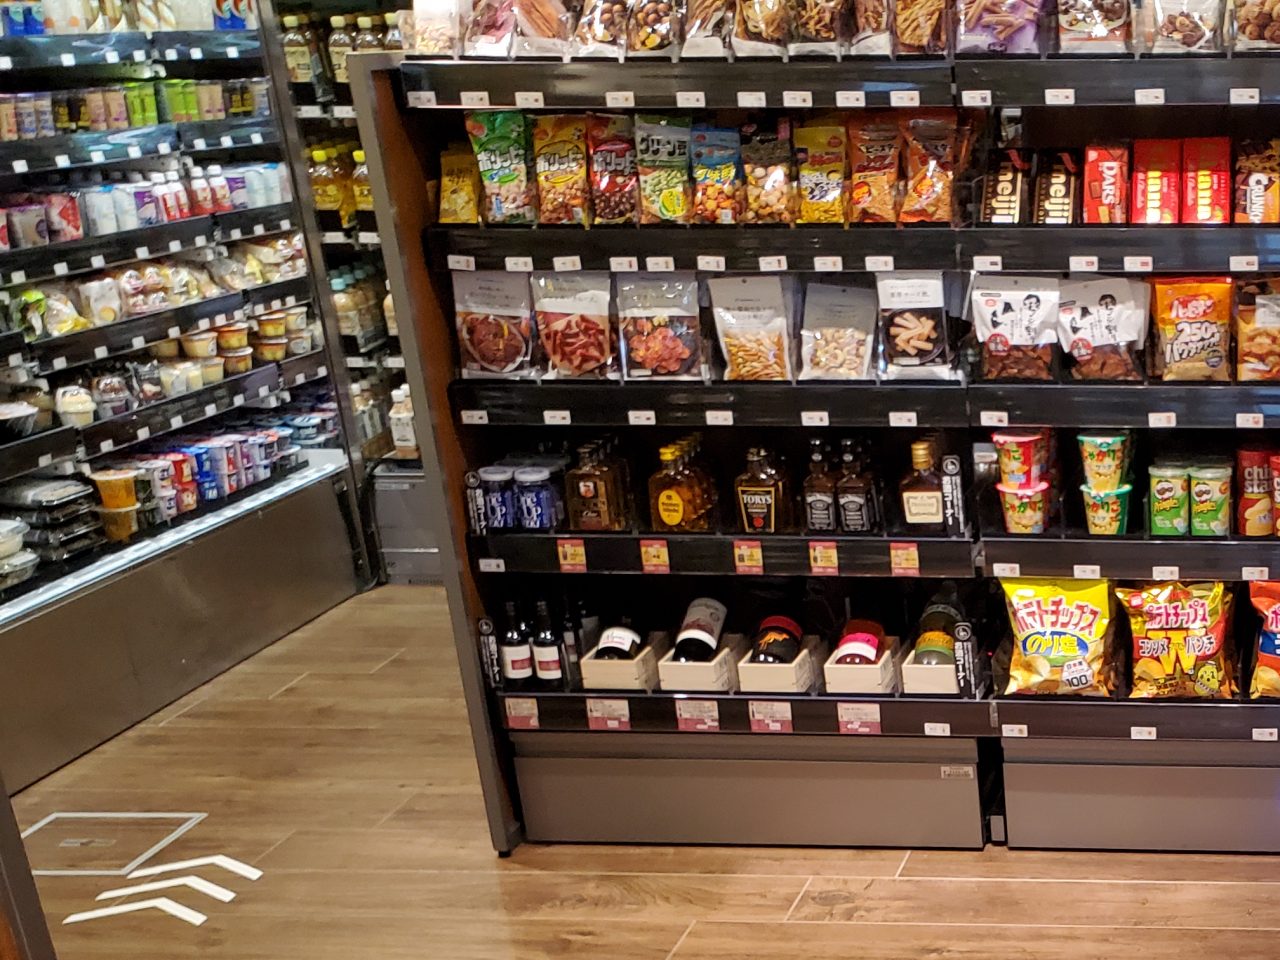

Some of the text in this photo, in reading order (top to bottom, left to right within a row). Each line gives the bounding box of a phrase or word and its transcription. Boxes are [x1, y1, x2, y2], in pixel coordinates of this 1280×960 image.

[1102, 161, 1120, 205] DARS
[1244, 464, 1272, 481] chi
[1244, 478, 1272, 494] sta
[742, 493, 772, 505] TORYS
[1013, 596, 1101, 637] ポテトチップス
[1144, 599, 1210, 629] ポテトチップス
